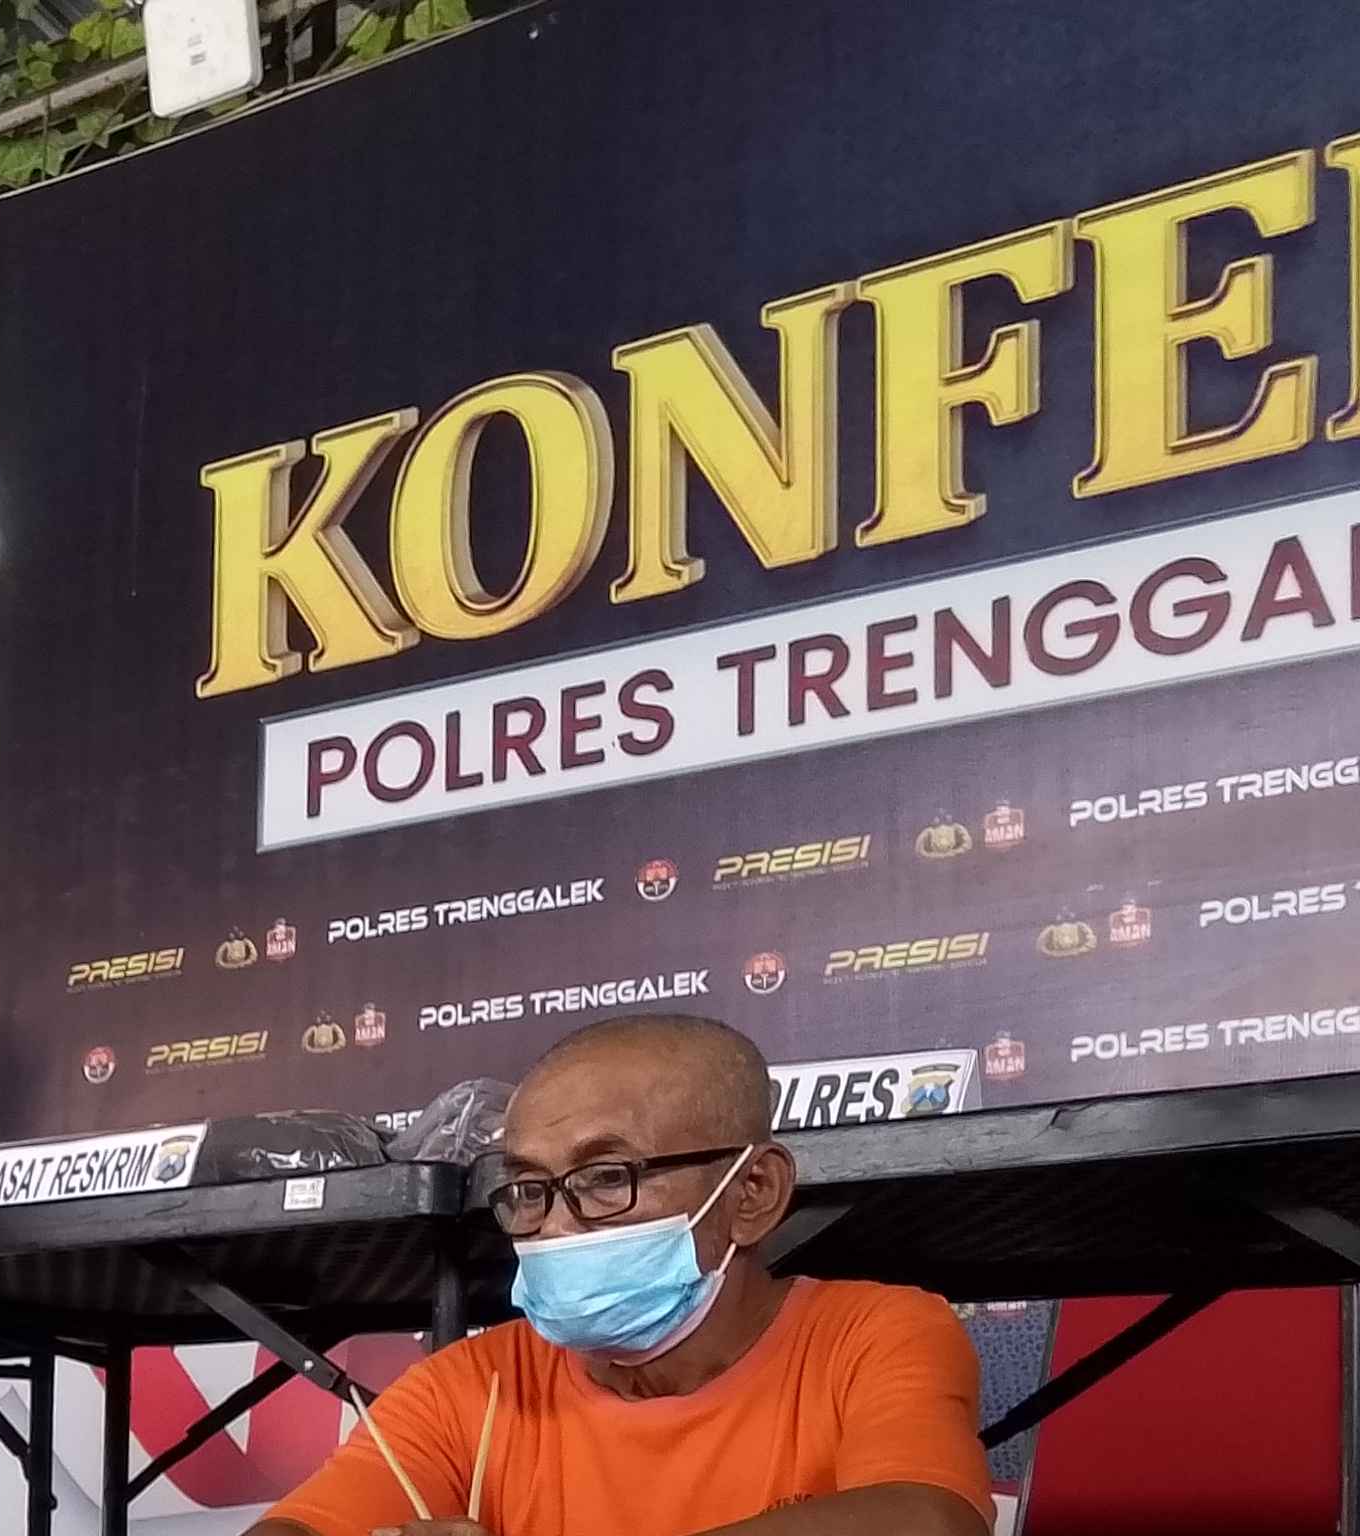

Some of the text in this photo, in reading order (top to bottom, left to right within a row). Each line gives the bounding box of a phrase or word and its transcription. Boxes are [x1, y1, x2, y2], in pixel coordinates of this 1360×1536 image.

[195, 132, 1360, 698] KONFE
[303, 522, 1360, 819] POLRES TRENGGA
[1070, 756, 1360, 827] POLRES TRENGG
[713, 834, 871, 882] PRESISI
[328, 878, 605, 943] POLRES TRENGGALEK
[1200, 883, 1346, 928] POLRES
[68, 947, 184, 986] PRESISI
[824, 931, 990, 976] PRESISI
[419, 969, 710, 1031] POLRES TRENGGALEK
[147, 1030, 268, 1067] PRESISI
[1071, 1005, 1360, 1063] POLRES TRENGG
[49, 1143, 158, 1196] RESKRIM
